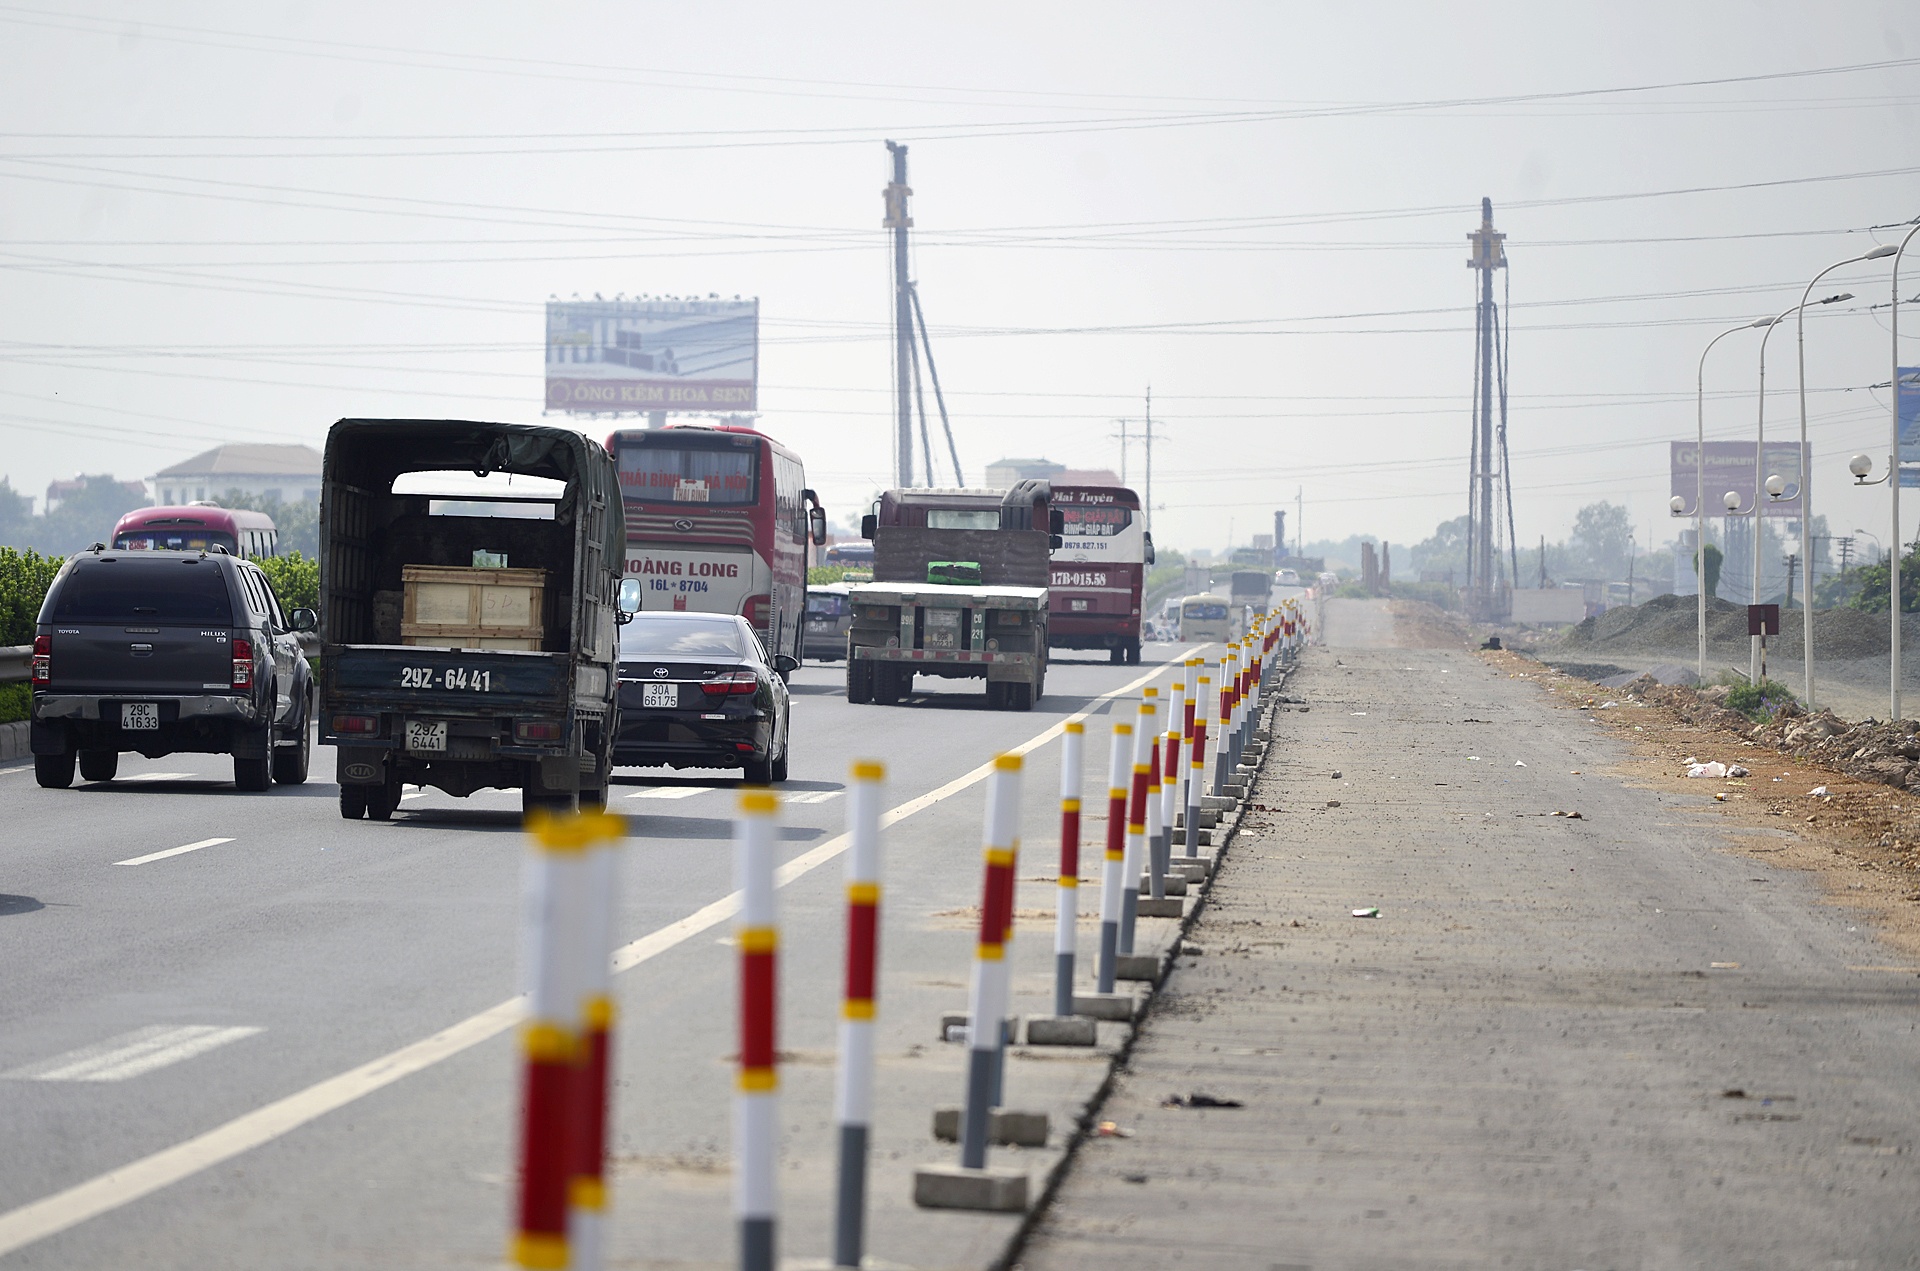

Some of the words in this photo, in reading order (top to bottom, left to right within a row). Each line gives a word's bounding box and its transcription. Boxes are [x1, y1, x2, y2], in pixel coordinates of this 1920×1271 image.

[669, 387, 709, 402] HOA
[712, 387, 750, 402] SEN
[619, 468, 646, 487] THÁI
[650, 468, 680, 488] BÌNH
[724, 473, 748, 494] NỘI
[1052, 491, 1074, 502] Mai
[688, 561, 739, 578] LONG
[200, 630, 227, 638] HILUX
[652, 685, 670, 695] 30A
[644, 695, 677, 707] 661.75
[130, 704, 150, 716] 29C
[122, 717, 158, 729] 416.33
[414, 723, 438, 736] 29Z
[411, 736, 441, 749] 6441
[350, 766, 371, 777] KIA
